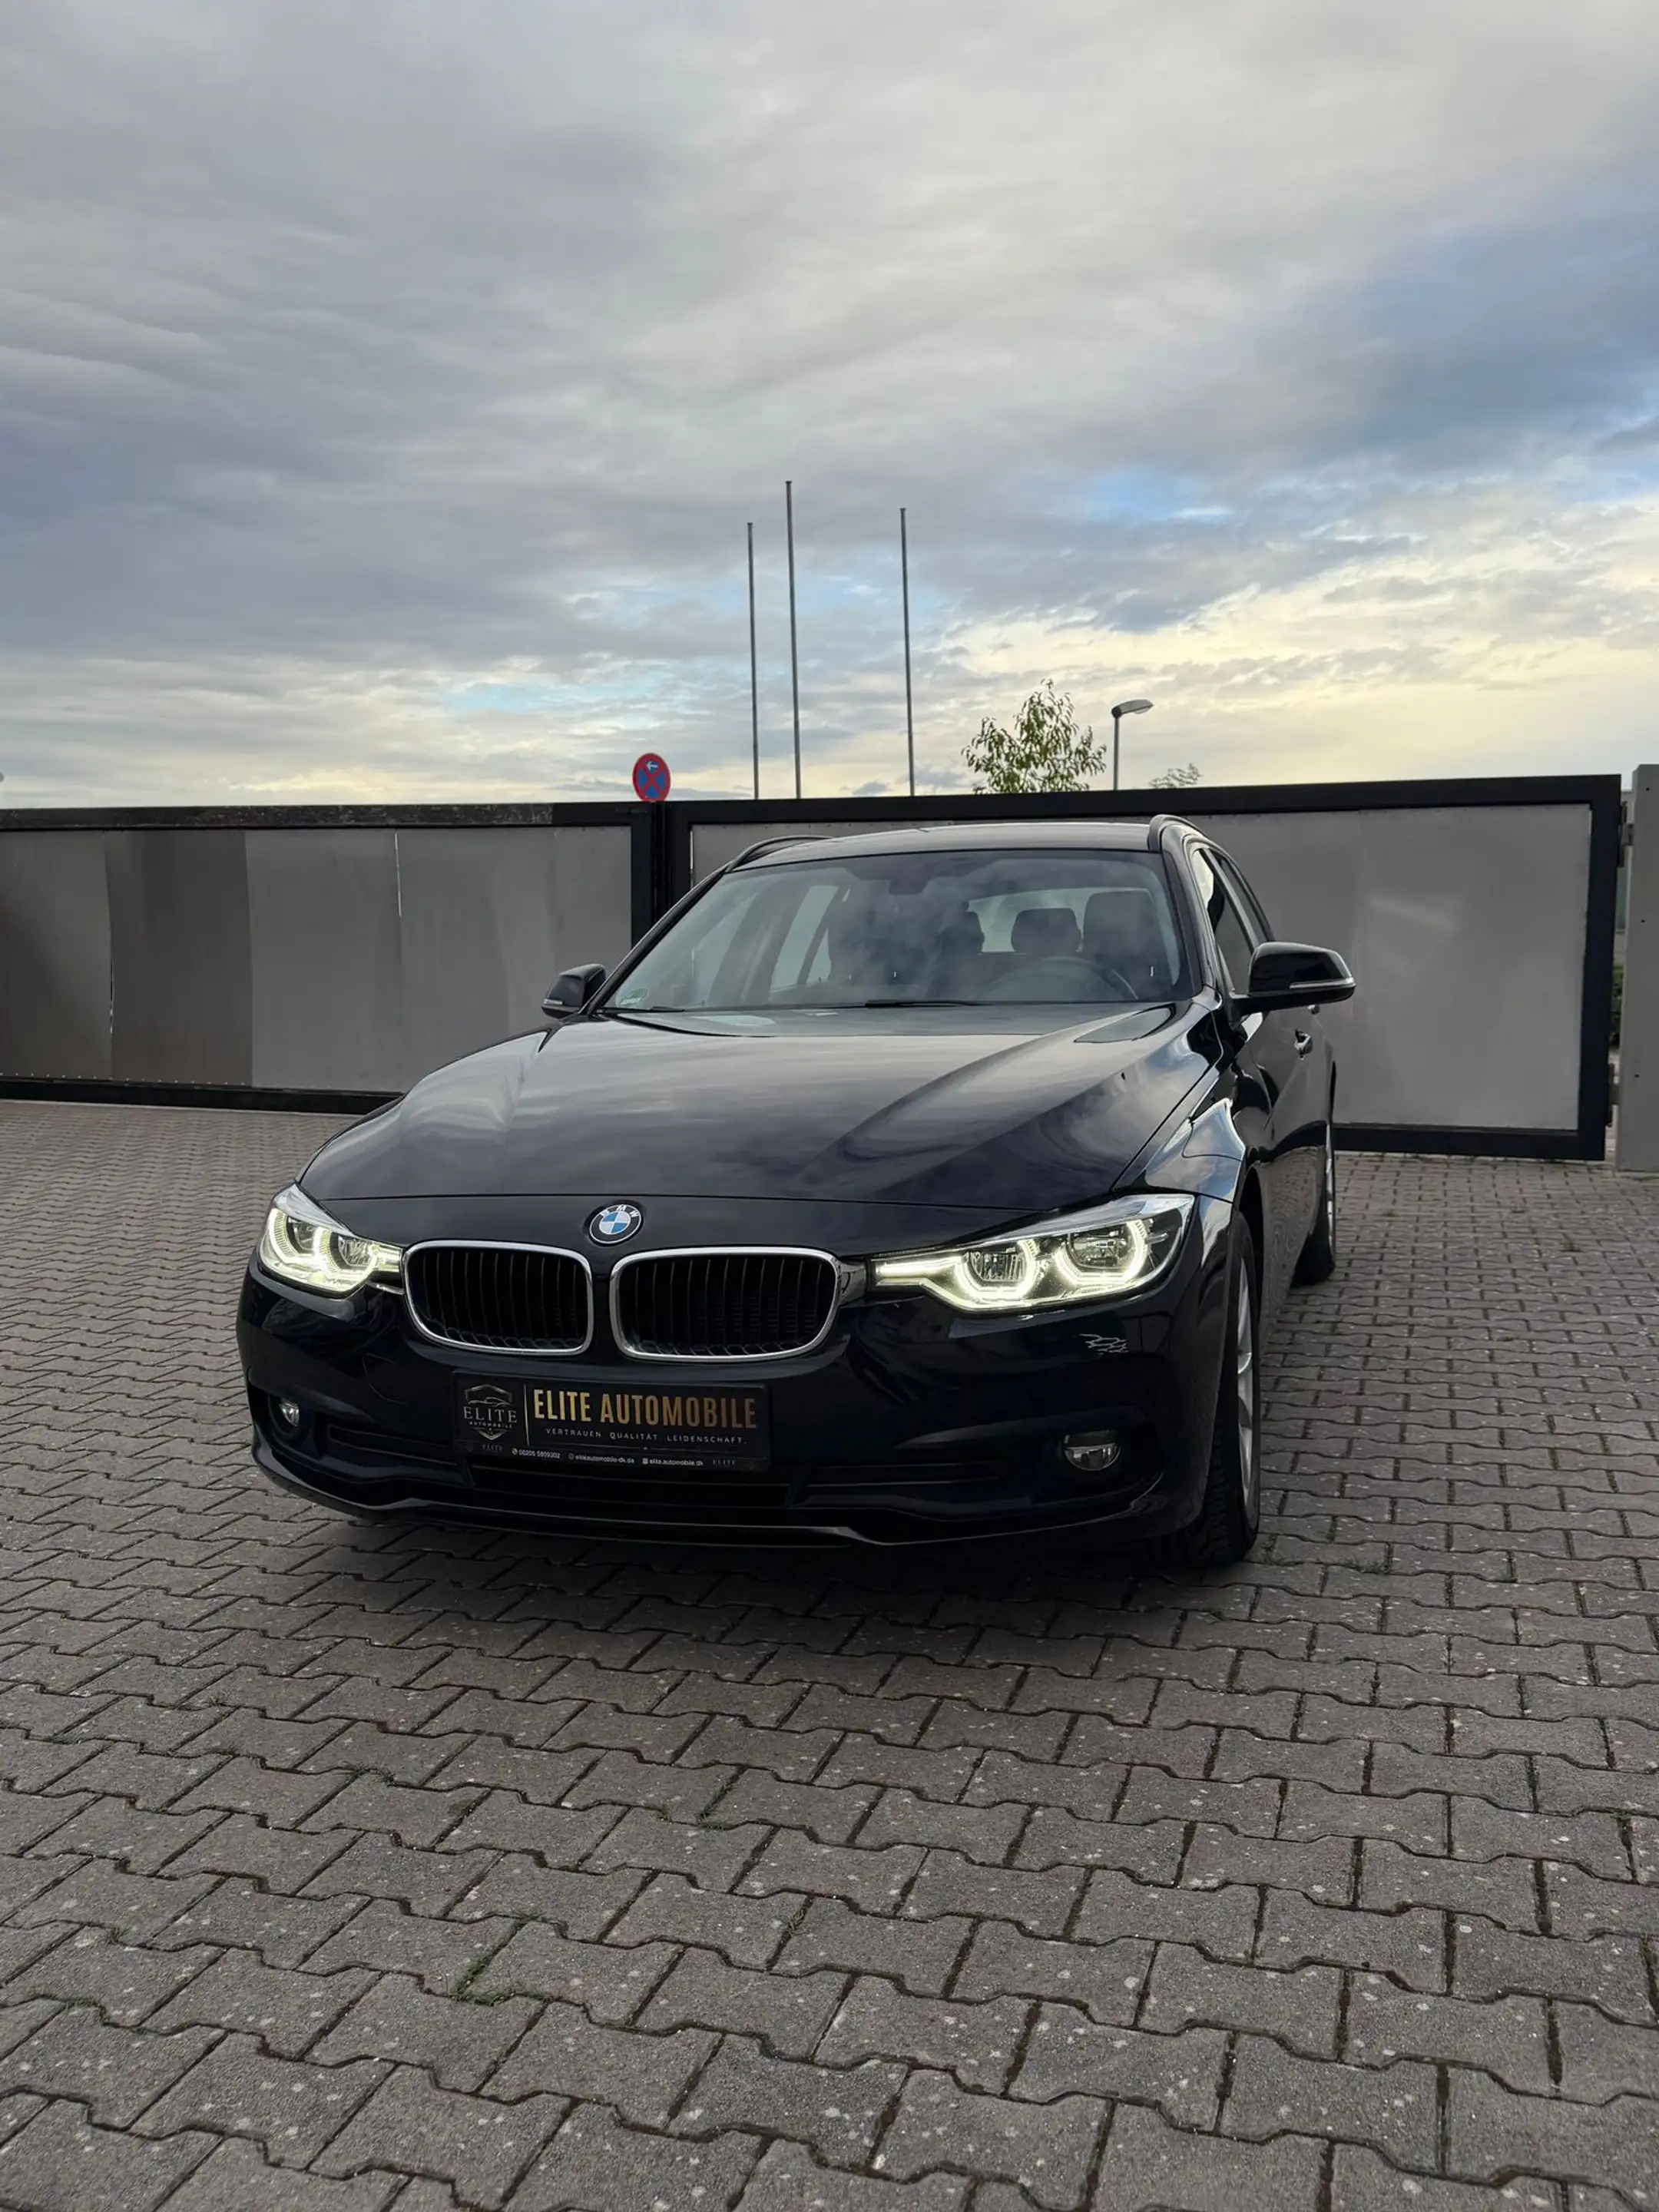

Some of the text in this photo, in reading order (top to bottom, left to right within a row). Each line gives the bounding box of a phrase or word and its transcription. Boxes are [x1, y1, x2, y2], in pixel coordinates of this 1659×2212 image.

[599, 1205, 640, 1217] BMW
[464, 1406, 517, 1422] ELITE
[533, 1389, 757, 1429] ELITE AUTOMOBILE
[545, 1427, 602, 1439] VERTRAUEN
[609, 1431, 658, 1441] QUALITÄT
